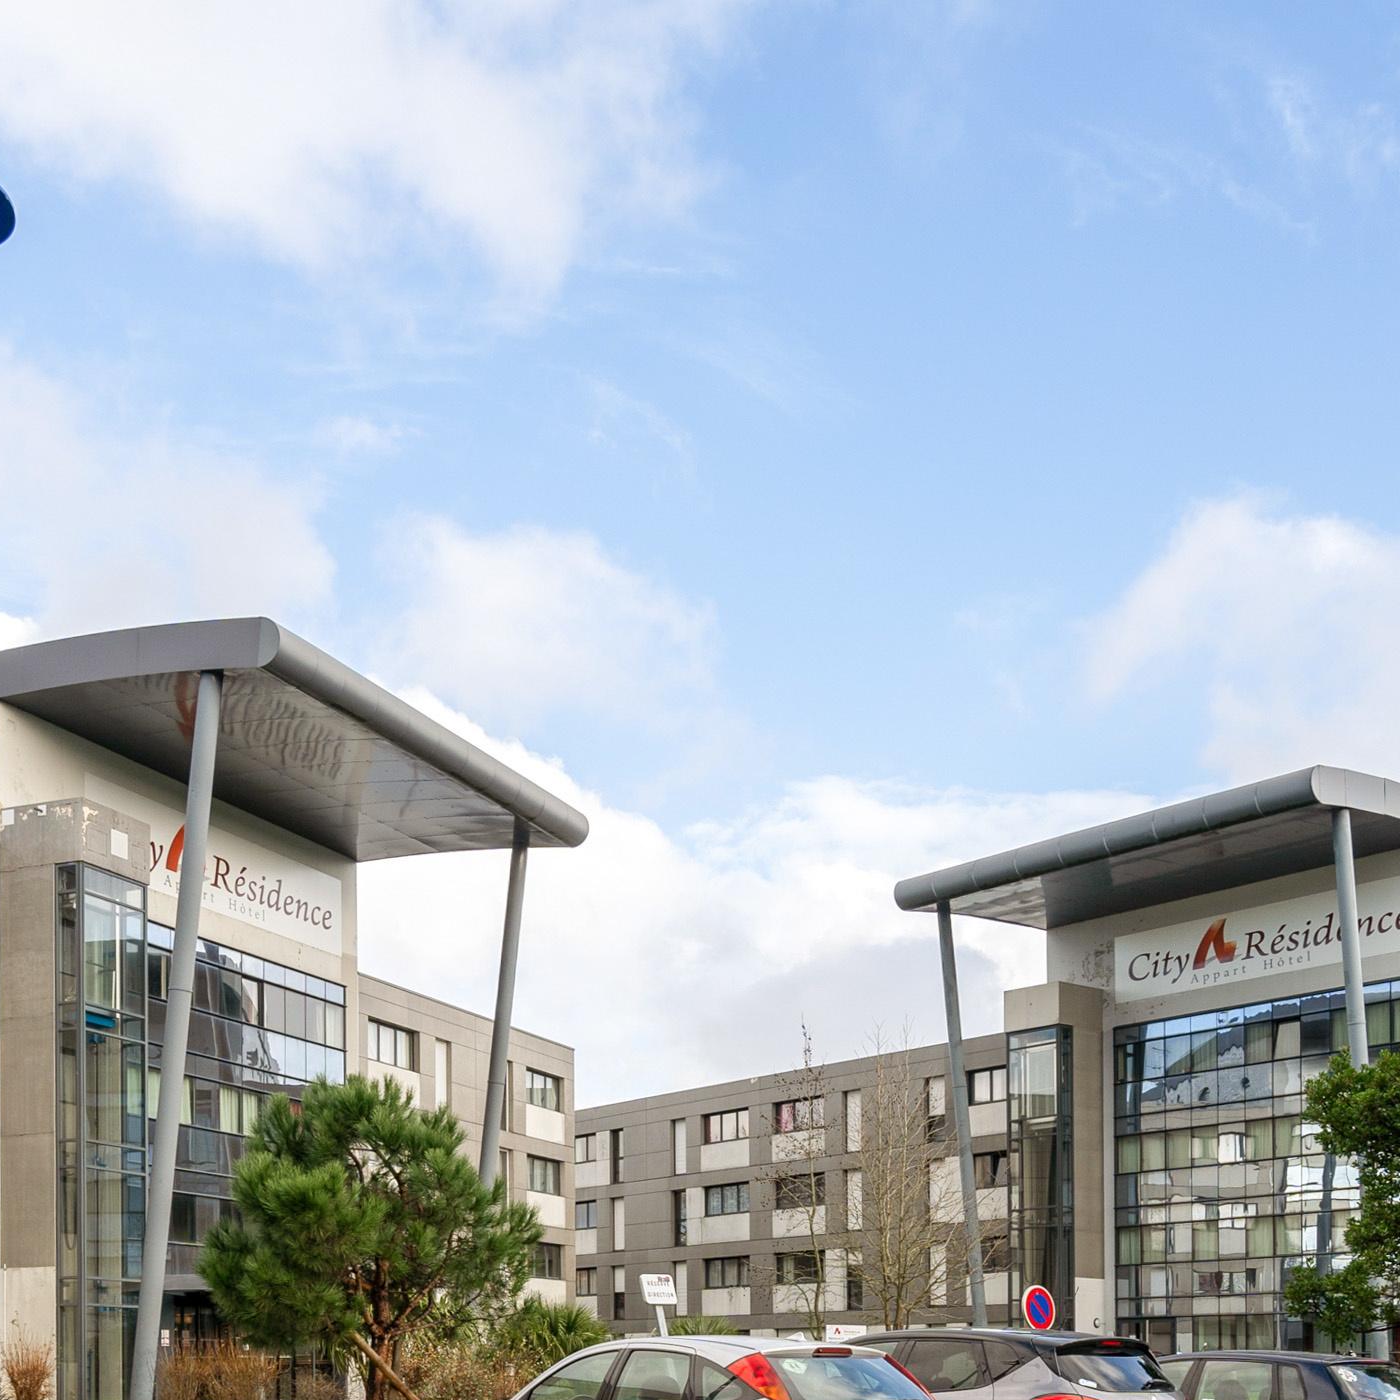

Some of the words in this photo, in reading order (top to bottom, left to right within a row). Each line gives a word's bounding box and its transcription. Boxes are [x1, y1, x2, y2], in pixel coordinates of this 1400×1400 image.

[210, 855, 333, 930] Résidence
[1128, 950, 1190, 985] City
[1190, 965, 1247, 985] Appart
[1263, 950, 1311, 970] Hôtel
